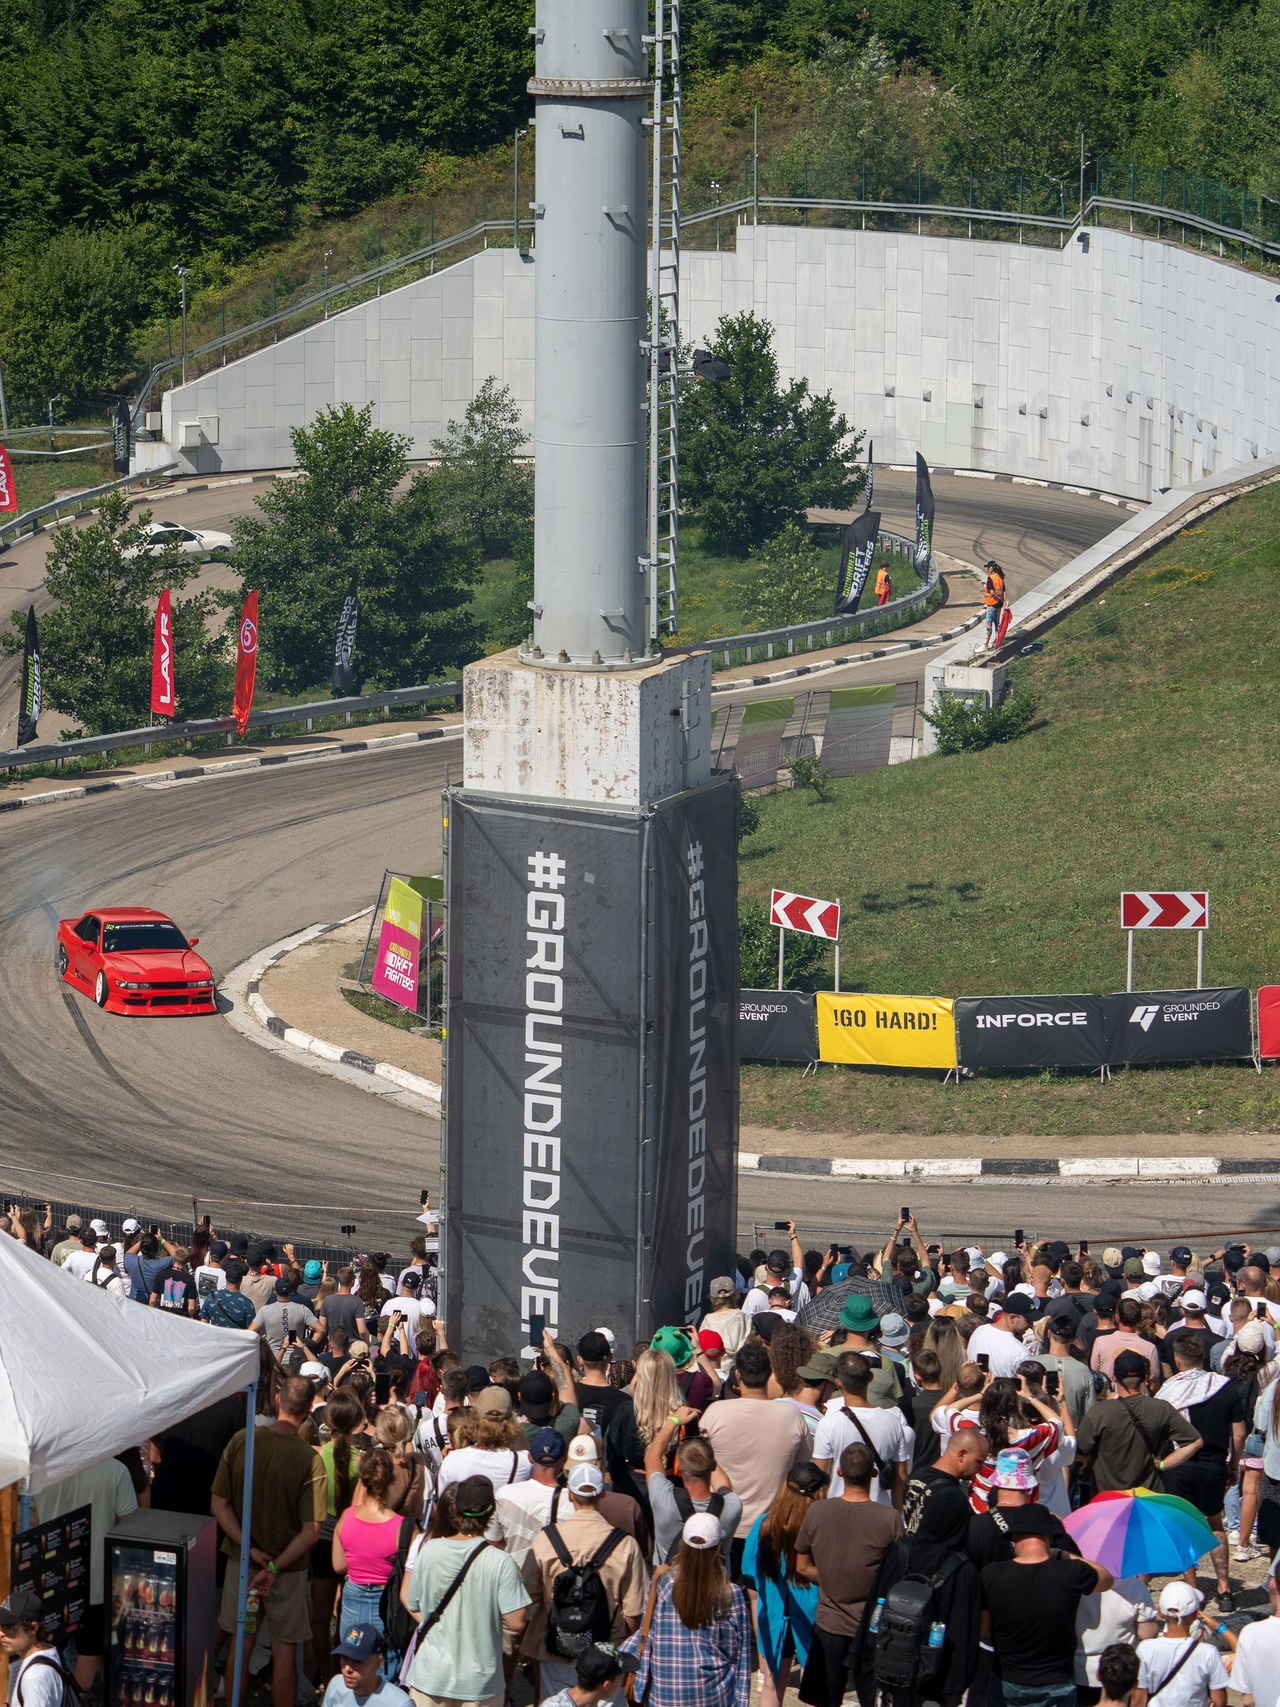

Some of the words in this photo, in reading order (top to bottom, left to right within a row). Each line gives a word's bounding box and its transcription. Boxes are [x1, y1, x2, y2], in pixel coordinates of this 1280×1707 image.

[849, 546, 865, 596] DRIFT
[160, 612, 171, 704] LAVR
[25, 655, 34, 716] GROUNDED
[387, 951, 414, 977] DRIFT
[384, 966, 415, 992] FIGHTERS
[739, 1012, 770, 1021] EVENT
[1163, 1001, 1220, 1013] GROUNDED
[1163, 1012, 1199, 1022] EVENT
[833, 1009, 866, 1028] !GO
[876, 1010, 937, 1031] HARD!
[975, 1012, 1088, 1029] INFORCE
